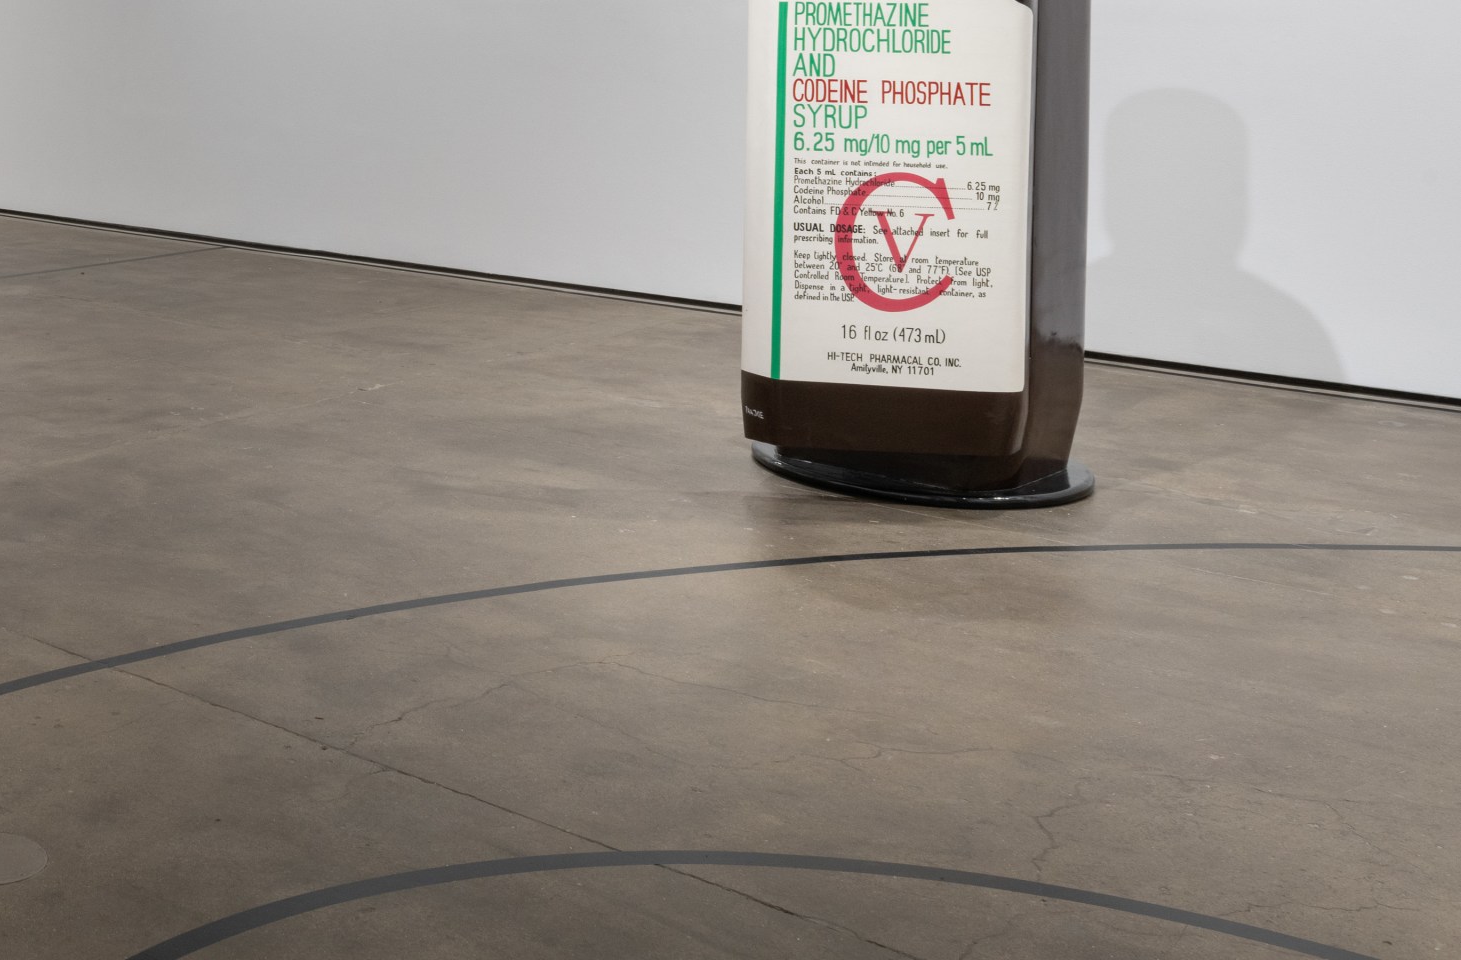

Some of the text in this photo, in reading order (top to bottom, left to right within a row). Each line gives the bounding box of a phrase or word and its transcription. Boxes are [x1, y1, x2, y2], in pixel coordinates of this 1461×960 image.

[795, 2, 929, 27] PROMETHAZINE
[794, 27, 951, 54] HYDROCHLORIDE
[793, 53, 835, 77] AND
[793, 79, 991, 106] CODEINE PHOSPHATE
[794, 104, 867, 129] SYRUP
[794, 132, 993, 158] 6.25 mg/10 mg per 5 mL
[794, 175, 1000, 193] Promethazine Hydrochloride 6.25 mg
[794, 185, 824, 194] Codeine
[827, 186, 866, 196] Phosphate
[976, 192, 984, 200] 10
[794, 195, 824, 204] Alcohol
[987, 202, 991, 210] 7
[794, 205, 826, 215] Contains
[831, 206, 840, 215] FD
[843, 207, 849, 215] &
[852, 207, 857, 216] C
[860, 208, 884, 216] Yellow
[900, 209, 904, 217] 6
[794, 223, 988, 238] USUAL DOSAGE: See attached insert for full
[794, 235, 878, 244] prescribing information.
[834, 172, 955, 312] C V
[794, 250, 810, 260] Keep
[814, 251, 836, 261] tightly
[843, 252, 867, 261] closed.
[875, 253, 893, 262] Store
[936, 256, 979, 266] temperature
[795, 261, 824, 269] between
[847, 263, 860, 271] and
[866, 263, 882, 272] 25°C
[909, 265, 921, 273] and
[976, 268, 991, 276] USP
[795, 270, 829, 280] Controlled
[835, 271, 854, 280] Room
[917, 275, 941, 285] Protect
[951, 277, 967, 285] from
[973, 278, 993, 288] light,
[795, 280, 824, 291] Dispense
[850, 284, 869, 293] tight,
[940, 288, 974, 298] container,
[795, 291, 820, 300] defined
[830, 293, 839, 301] the
[842, 324, 945, 344] 16 fl oz (473 mL)
[828, 352, 862, 362] HI-TECH
[870, 354, 923, 365] PHARMACAL
[945, 358, 961, 367] INC.
[851, 363, 934, 375] Amityville, NY 11701
